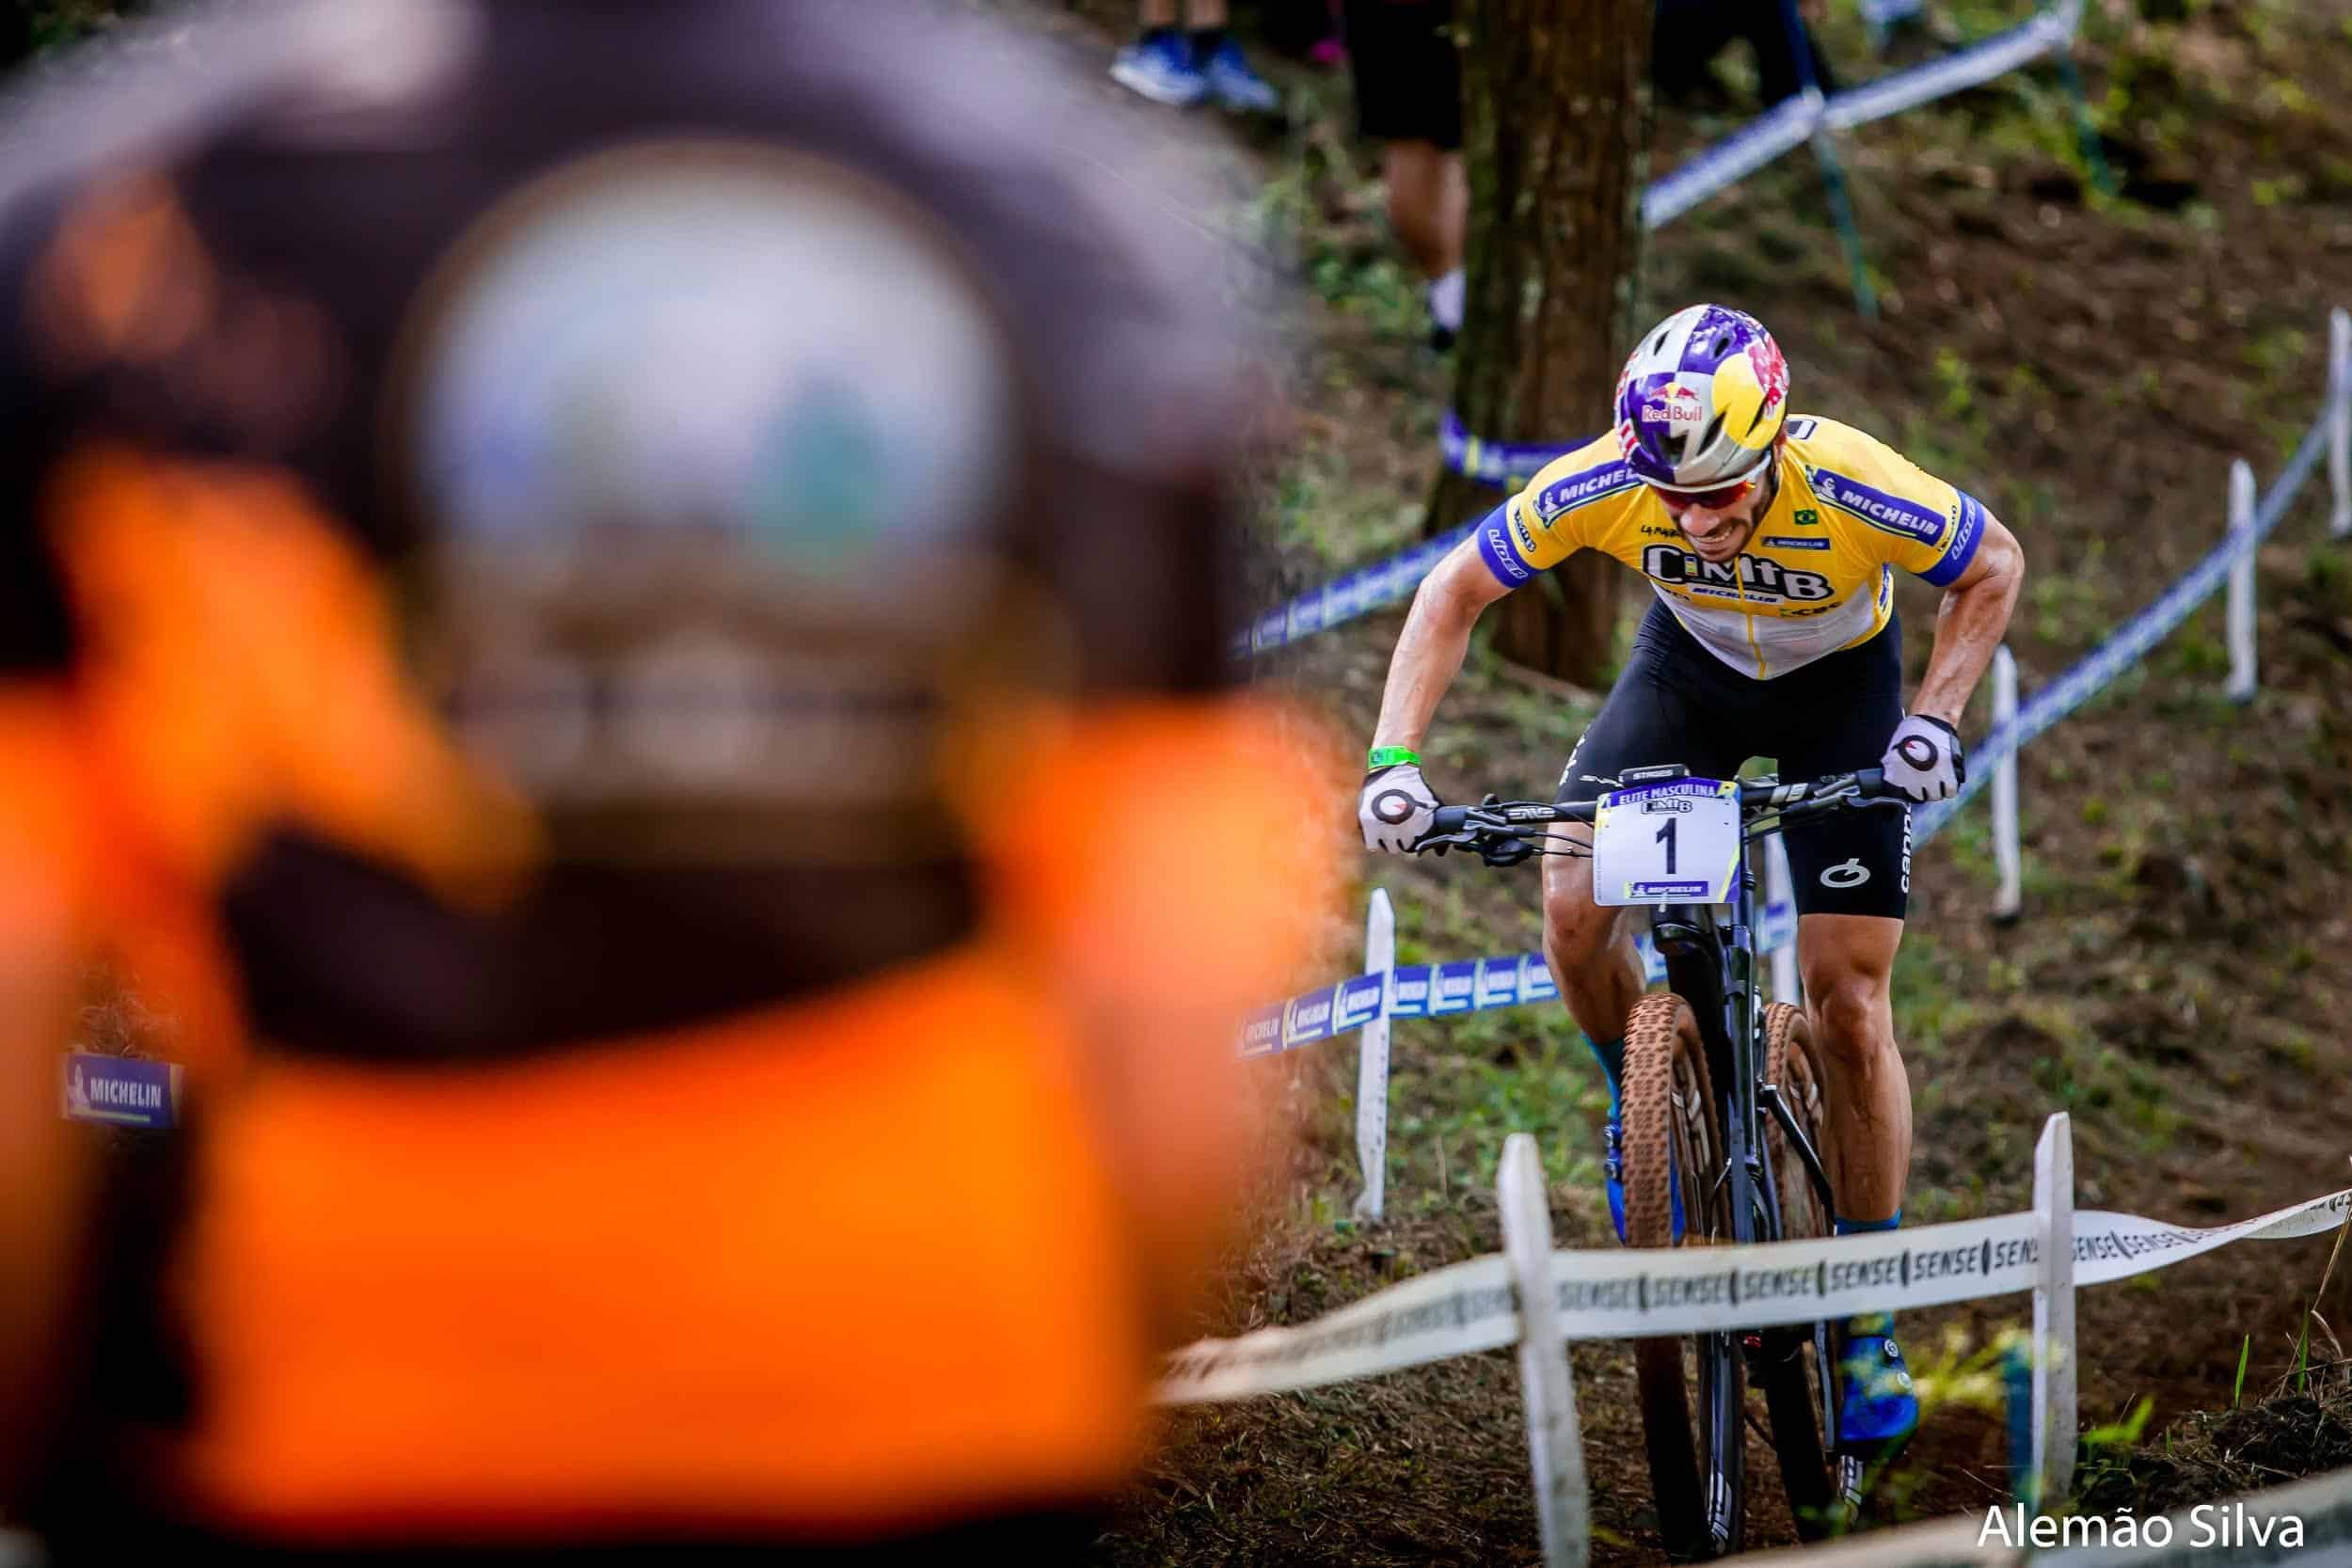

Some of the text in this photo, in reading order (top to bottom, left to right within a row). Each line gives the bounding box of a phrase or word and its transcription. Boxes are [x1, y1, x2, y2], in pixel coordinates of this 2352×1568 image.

[1642, 404, 1702, 421] Red Bull
[1559, 468, 1637, 503] MICHEL
[1840, 490, 1939, 535] MICHELIN
[1618, 784, 1717, 805] ELITE MASCULINA
[1656, 817, 1677, 875] 1
[90, 1077, 162, 1108] MICHELIN
[1744, 1267, 1812, 1300] SENSE
[1831, 1254, 1896, 1291] SENSE
[1913, 1246, 1980, 1280] SENSE
[1994, 1237, 2040, 1268] SENS
